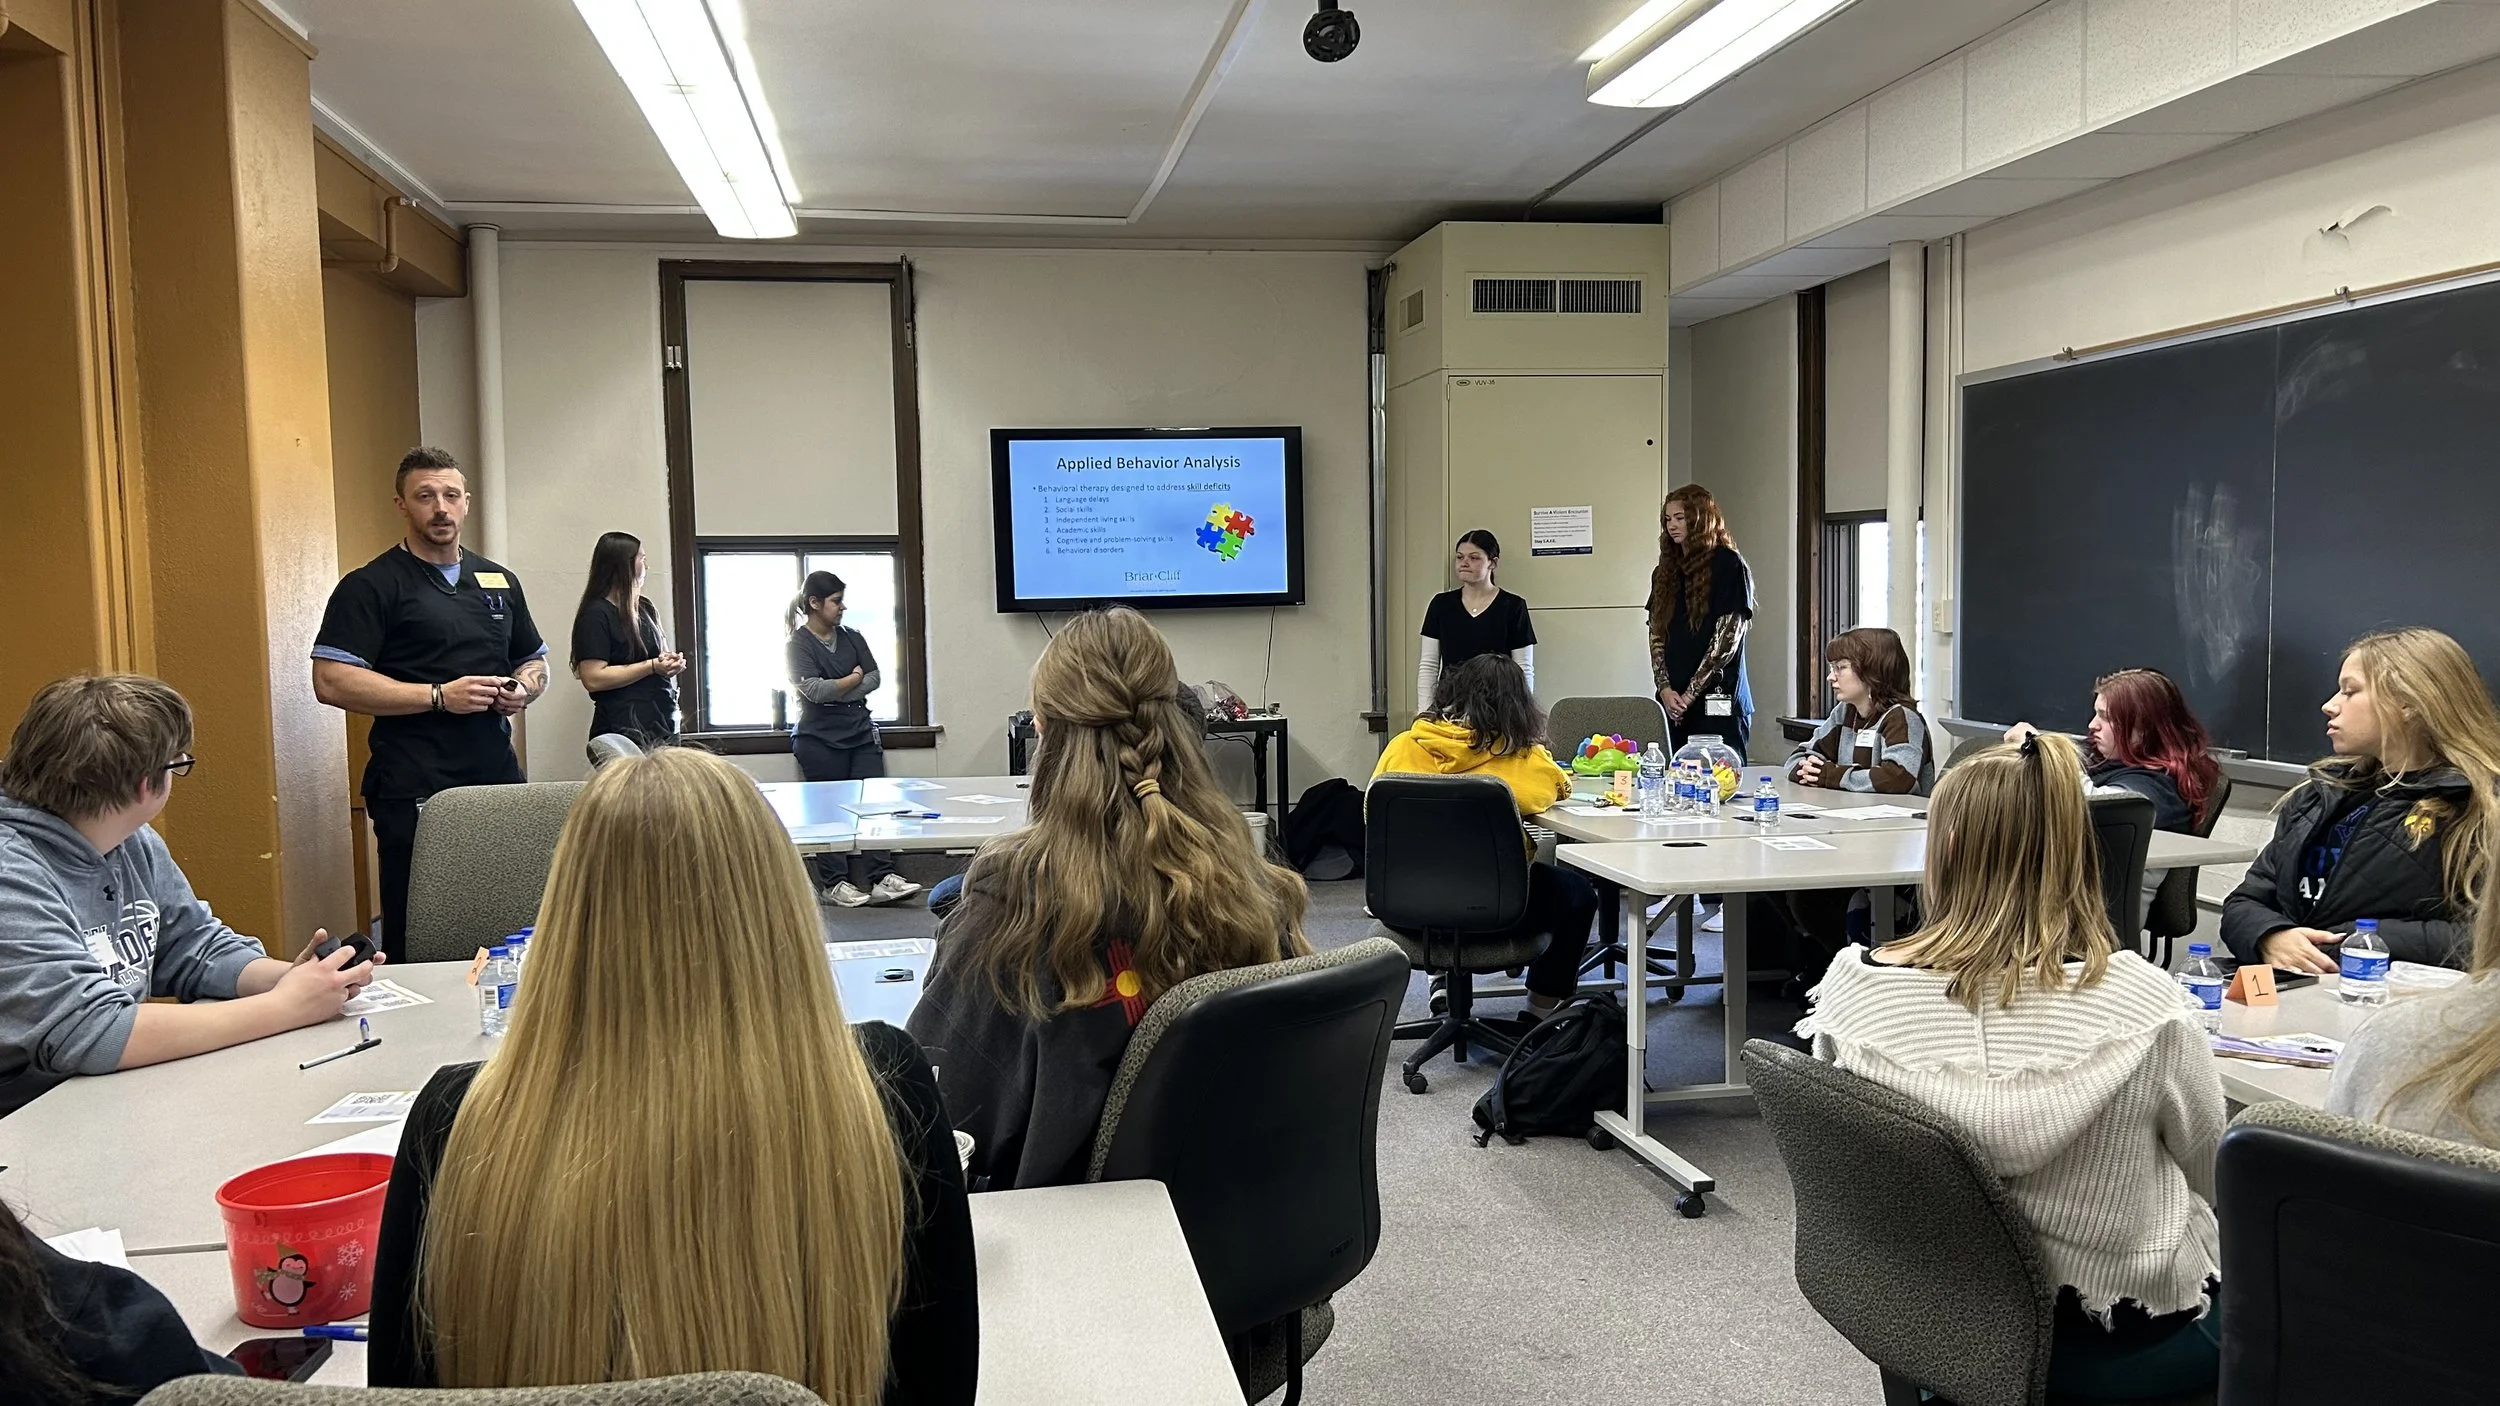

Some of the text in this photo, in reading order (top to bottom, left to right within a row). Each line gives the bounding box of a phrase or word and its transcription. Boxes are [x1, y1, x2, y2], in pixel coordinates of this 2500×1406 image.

[1056, 456, 1240, 472] Applied Behavior Analysis
[1080, 484, 1108, 493] therapy
[1111, 484, 1144, 492] designed
[1187, 483, 1202, 491] skill
[1204, 483, 1231, 491] deficits
[1056, 496, 1087, 504] Language
[1088, 496, 1109, 504] delays
[1620, 776, 1628, 785] 3
[2252, 974, 2269, 996] 1
